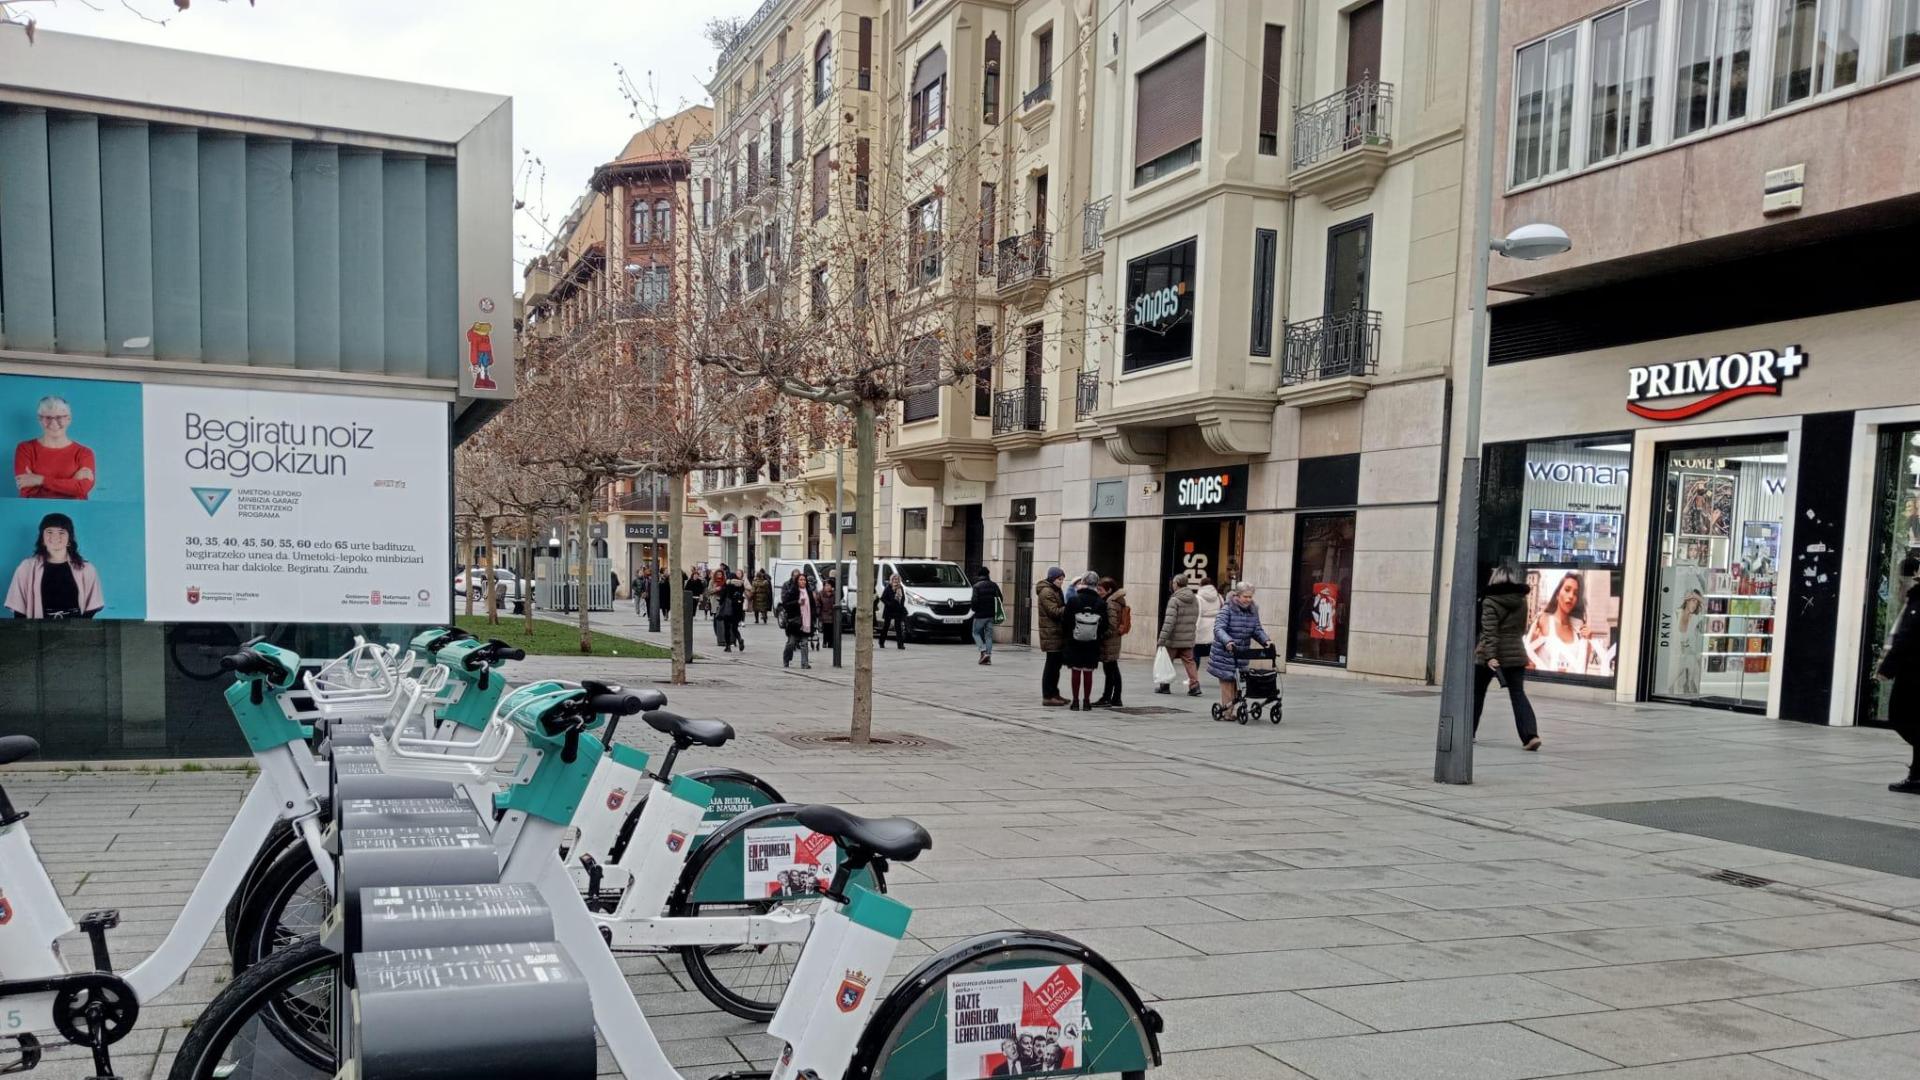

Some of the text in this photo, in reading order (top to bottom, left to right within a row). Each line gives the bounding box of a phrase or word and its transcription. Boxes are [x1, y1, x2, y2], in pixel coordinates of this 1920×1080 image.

[1134, 284, 1179, 327] snipes
[185, 412, 374, 449] Begiratu noiz
[185, 441, 347, 478] dagokizun
[238, 488, 302, 497] UMETOKI-LEPOKO
[238, 496, 299, 505] MINBIZIA GARAIZ
[1178, 475, 1223, 510] snipes
[238, 504, 293, 512] DETEKTATZEKO
[238, 511, 281, 519] PROGRAMA
[629, 527, 664, 535] PARFOS
[185, 536, 202, 547] 30,
[296, 539, 312, 549] 60
[314, 540, 332, 550] edo
[334, 540, 348, 550] 65
[350, 541, 371, 551] urte
[185, 548, 246, 560] begiratzeko
[248, 552, 273, 560] unea
[292, 551, 373, 563] Umetoki-lepoko
[375, 554, 424, 564] minbiziari
[185, 563, 220, 572] aurrea
[222, 561, 240, 572] har
[1660, 612, 1672, 648] DKNY
[724, 796, 752, 805] RURAL
[759, 843, 791, 857] PRIMERA
[1036, 974, 1066, 1006] U25
[955, 993, 981, 1011] GAZTE
[6, 1009, 22, 1029] 5
[955, 1008, 999, 1027] LANGILEOK
[955, 1022, 1017, 1044] LEHEN LERRORA
